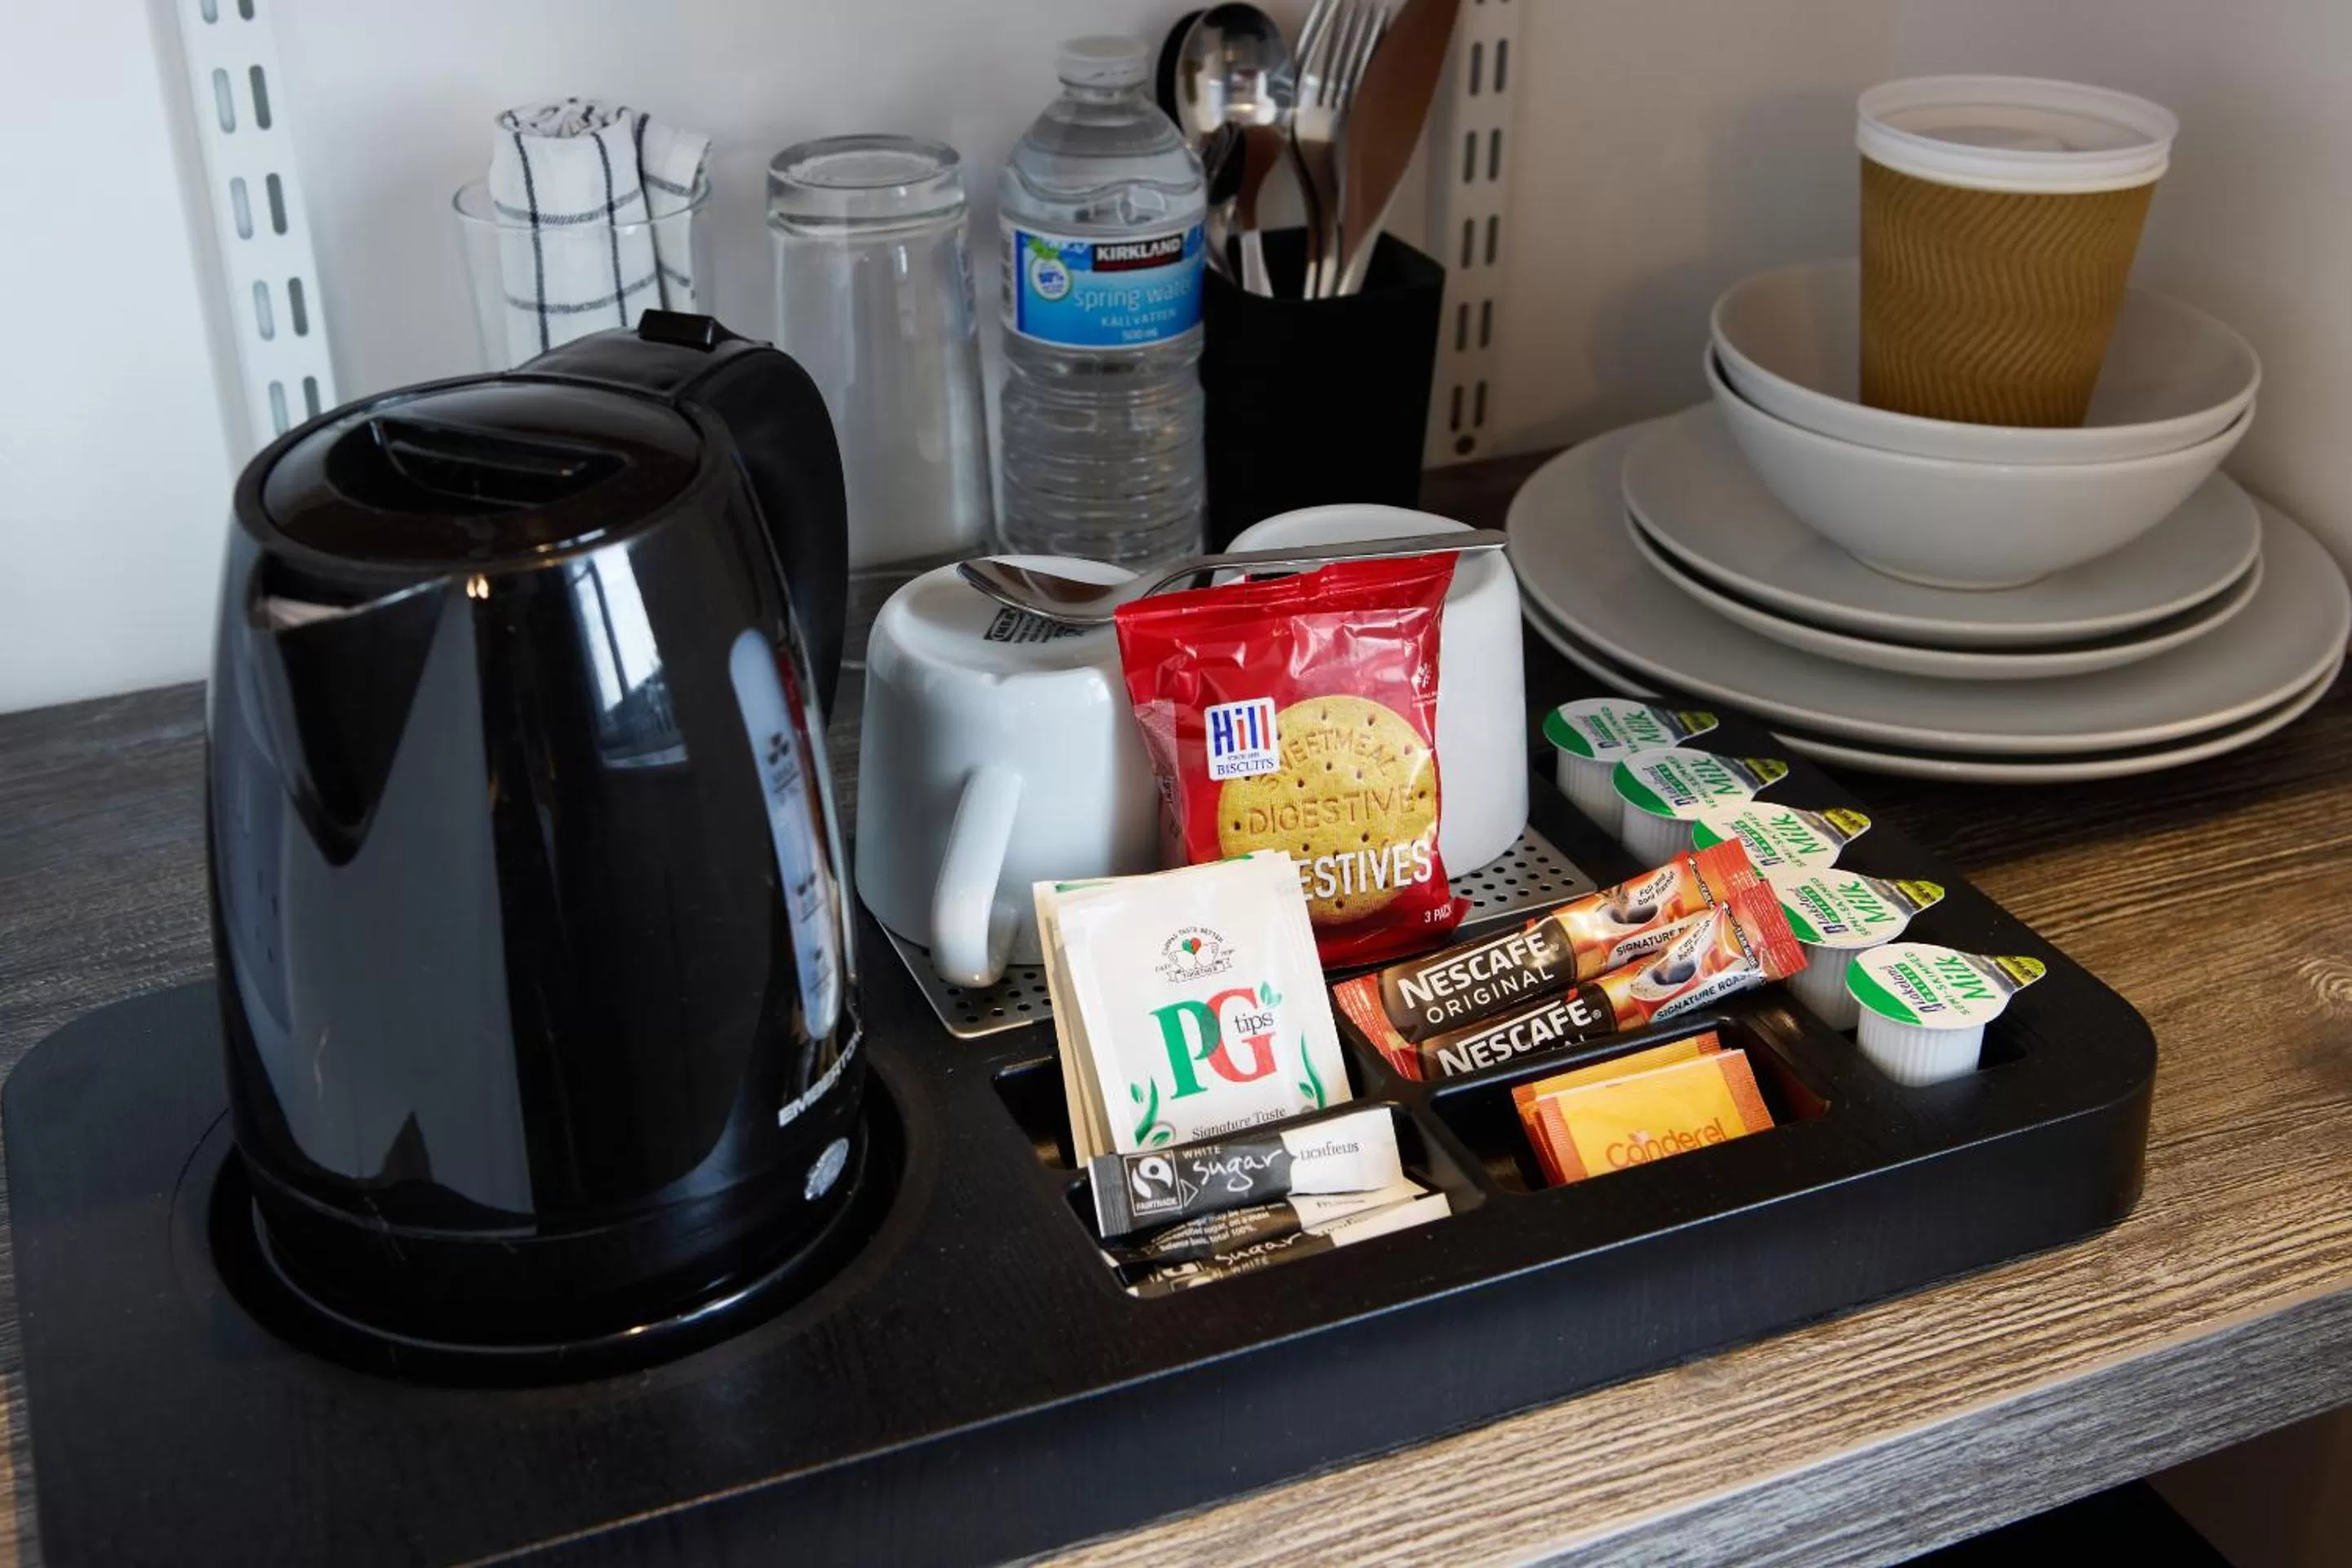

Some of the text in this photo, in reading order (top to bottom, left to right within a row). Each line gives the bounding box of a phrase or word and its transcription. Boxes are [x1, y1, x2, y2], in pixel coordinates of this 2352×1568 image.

[1096, 238, 1181, 262] KIRKLAND
[1074, 288, 1140, 312] spring
[1212, 704, 1271, 757] Hill
[1216, 758, 1274, 775] BISCUITS
[1691, 757, 1742, 795] Milk
[1248, 783, 1416, 836] DIGESTIVE
[1770, 813, 1828, 855] Milk
[1298, 838, 1433, 901] ESTIVES
[1423, 910, 1432, 924] 3
[1838, 881, 1896, 922] Milk
[1616, 929, 1674, 956] SIGNATURE
[1426, 967, 1555, 1024] ORIGINAL
[1904, 952, 1971, 1015] SEMI-SKIMMED
[1934, 955, 1996, 1000] Milk
[1234, 1010, 1275, 1035] tips
[1656, 986, 1715, 1020] SIGNATURE
[1149, 987, 1278, 1099] PG
[1255, 1106, 1287, 1129] Taste
[1182, 1145, 1222, 1160] WHITE
[1604, 1117, 1727, 1170] Canderel
[1193, 1148, 1283, 1192] sugar
[1230, 1255, 1271, 1275] WHITE
